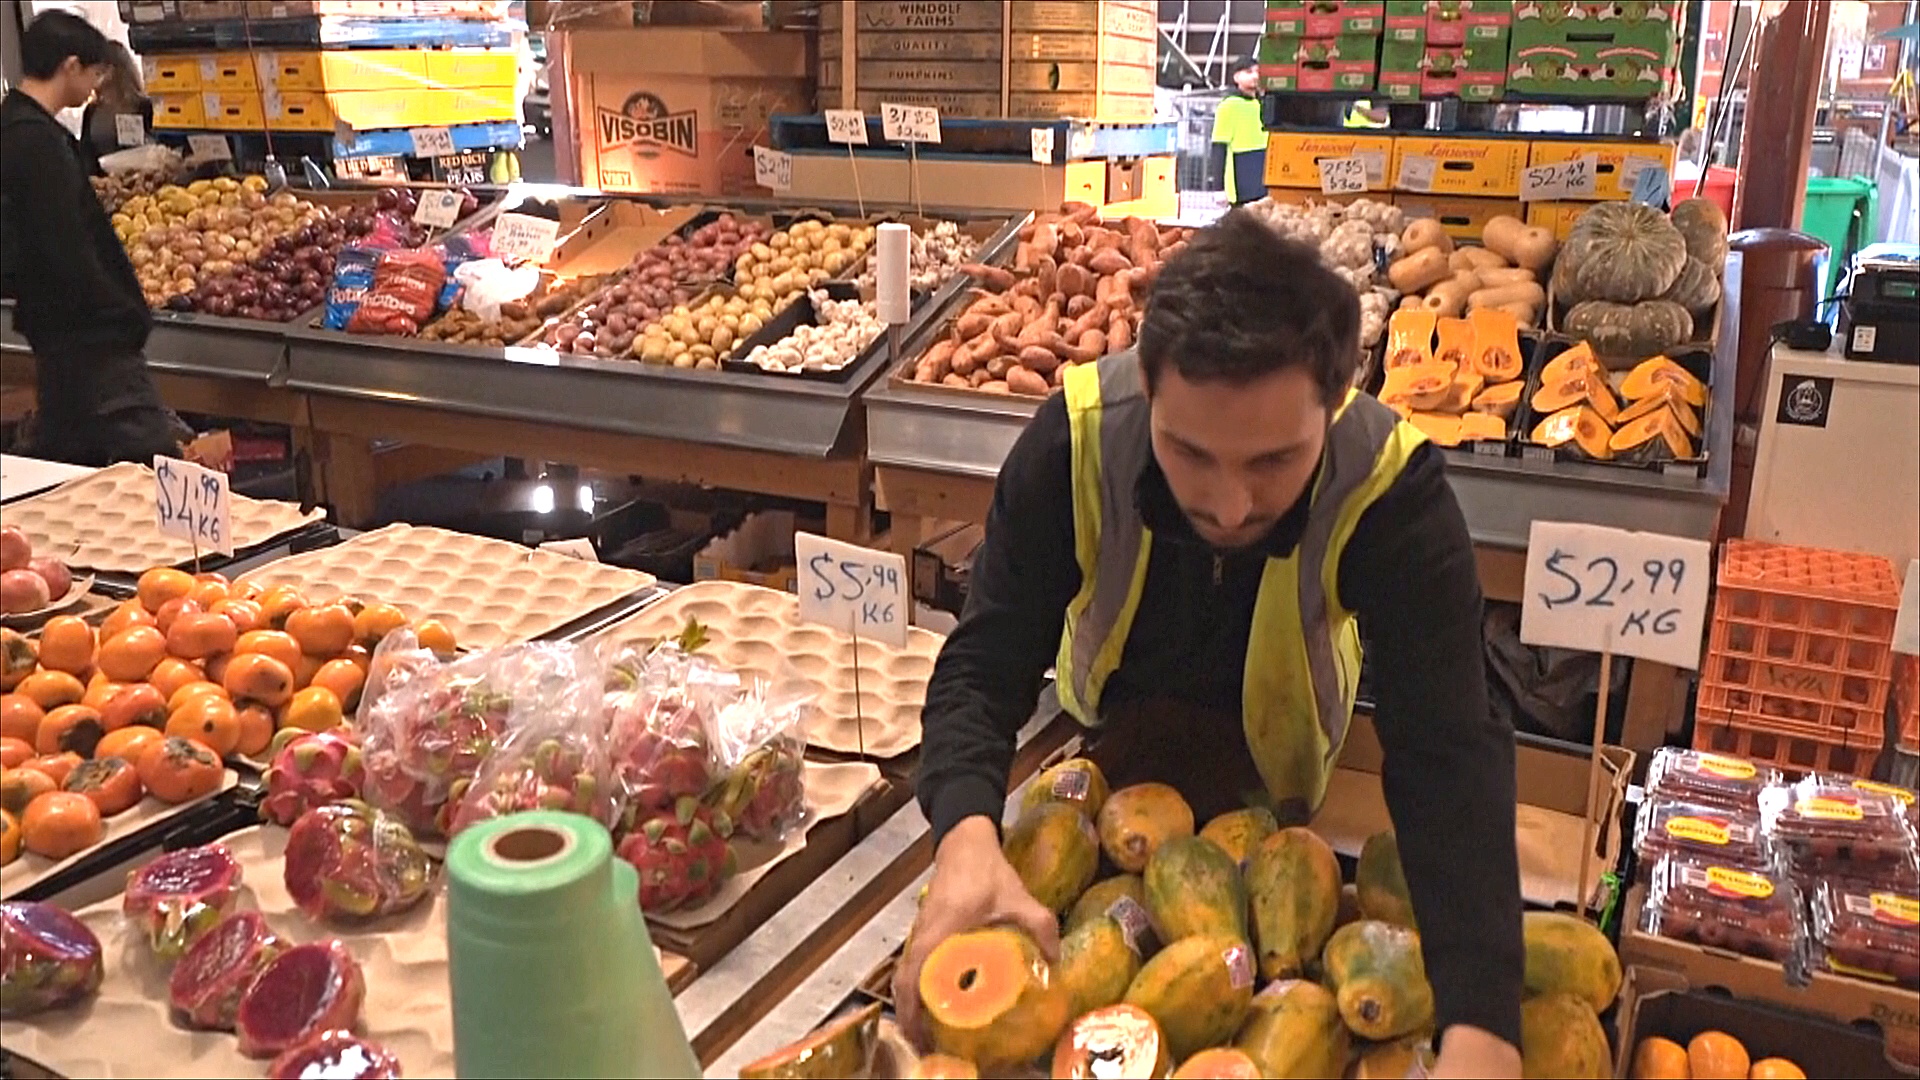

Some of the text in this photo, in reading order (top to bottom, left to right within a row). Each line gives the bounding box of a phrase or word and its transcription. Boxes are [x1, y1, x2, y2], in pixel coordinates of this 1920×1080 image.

[899, 3, 962, 14] WINDOLF
[906, 16, 955, 27] FARMS
[893, 42, 949, 51] QUALITY
[888, 71, 954, 81] PUMPKINS
[600, 114, 693, 150] VISOBIN
[440, 152, 486, 168] RED RICH
[447, 171, 485, 185] PEARS
[1565, 175, 1586, 189] KG
[199, 514, 220, 544] KG
[862, 602, 895, 625] KG
[1620, 608, 1682, 637] KG
